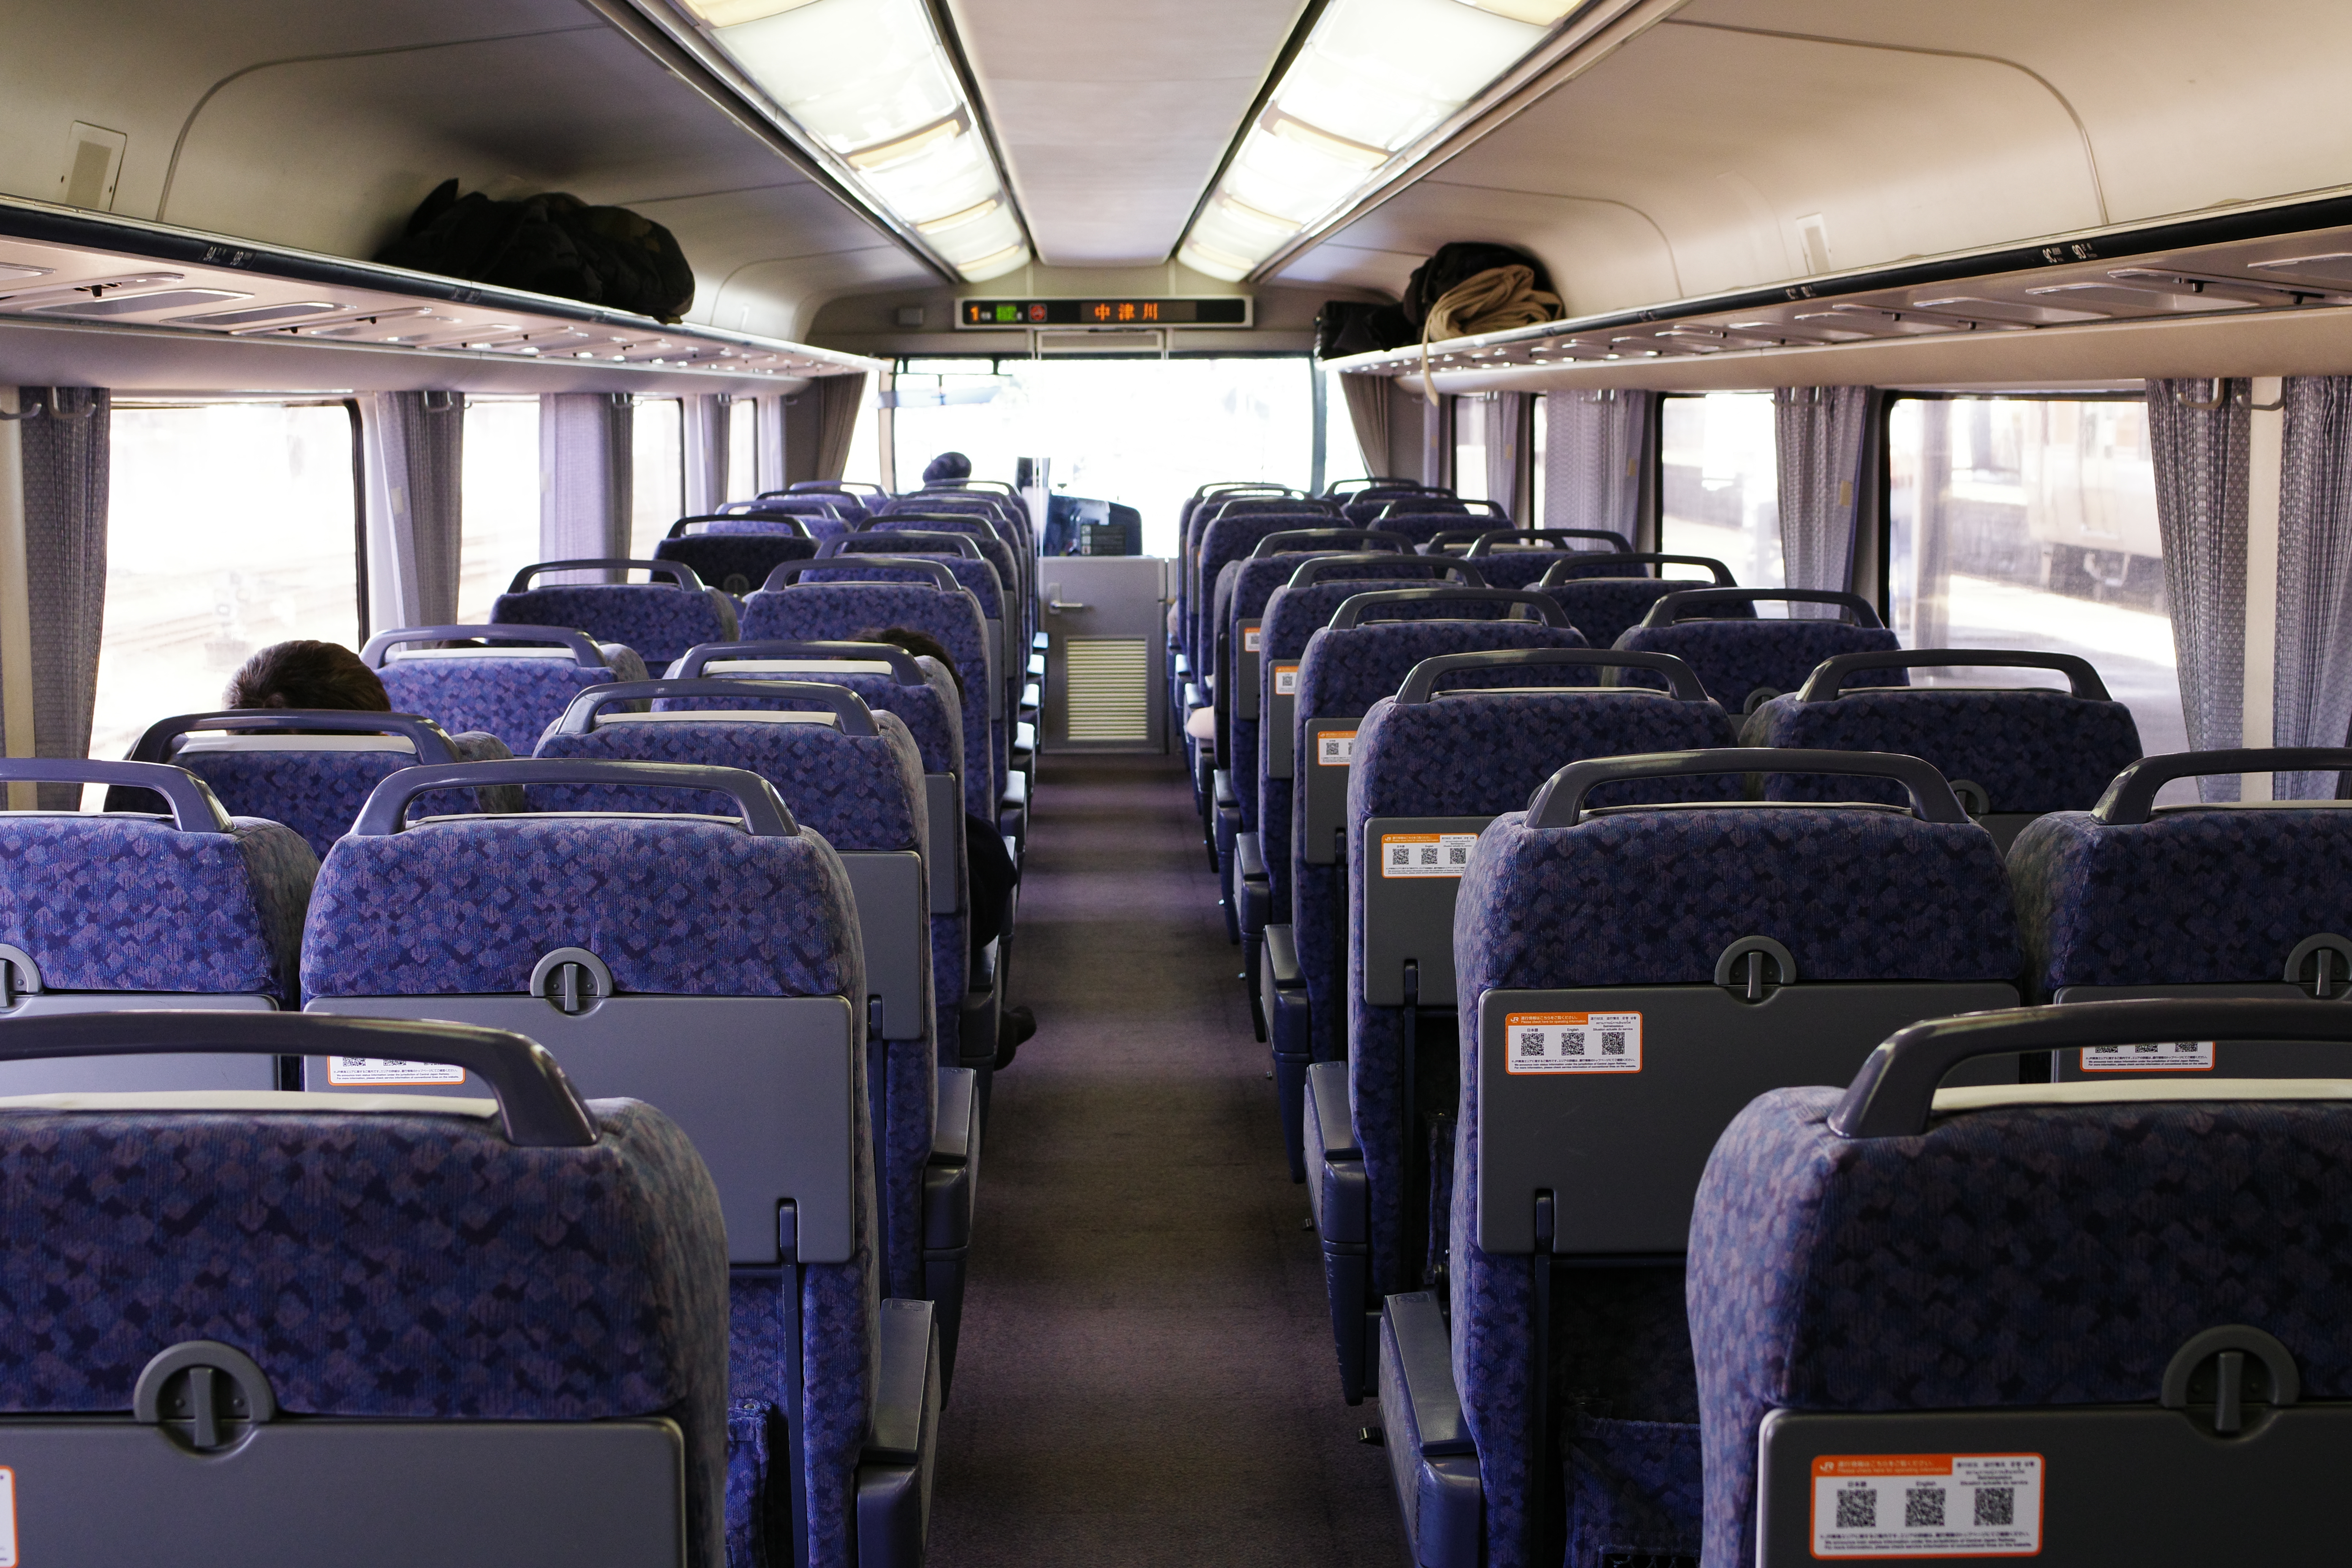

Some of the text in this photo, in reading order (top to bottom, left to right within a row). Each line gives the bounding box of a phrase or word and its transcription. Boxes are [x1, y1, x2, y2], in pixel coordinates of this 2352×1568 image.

[203, 246, 217, 261] 9A
[970, 306, 979, 321] 1
[1094, 303, 1158, 321] 中津川
